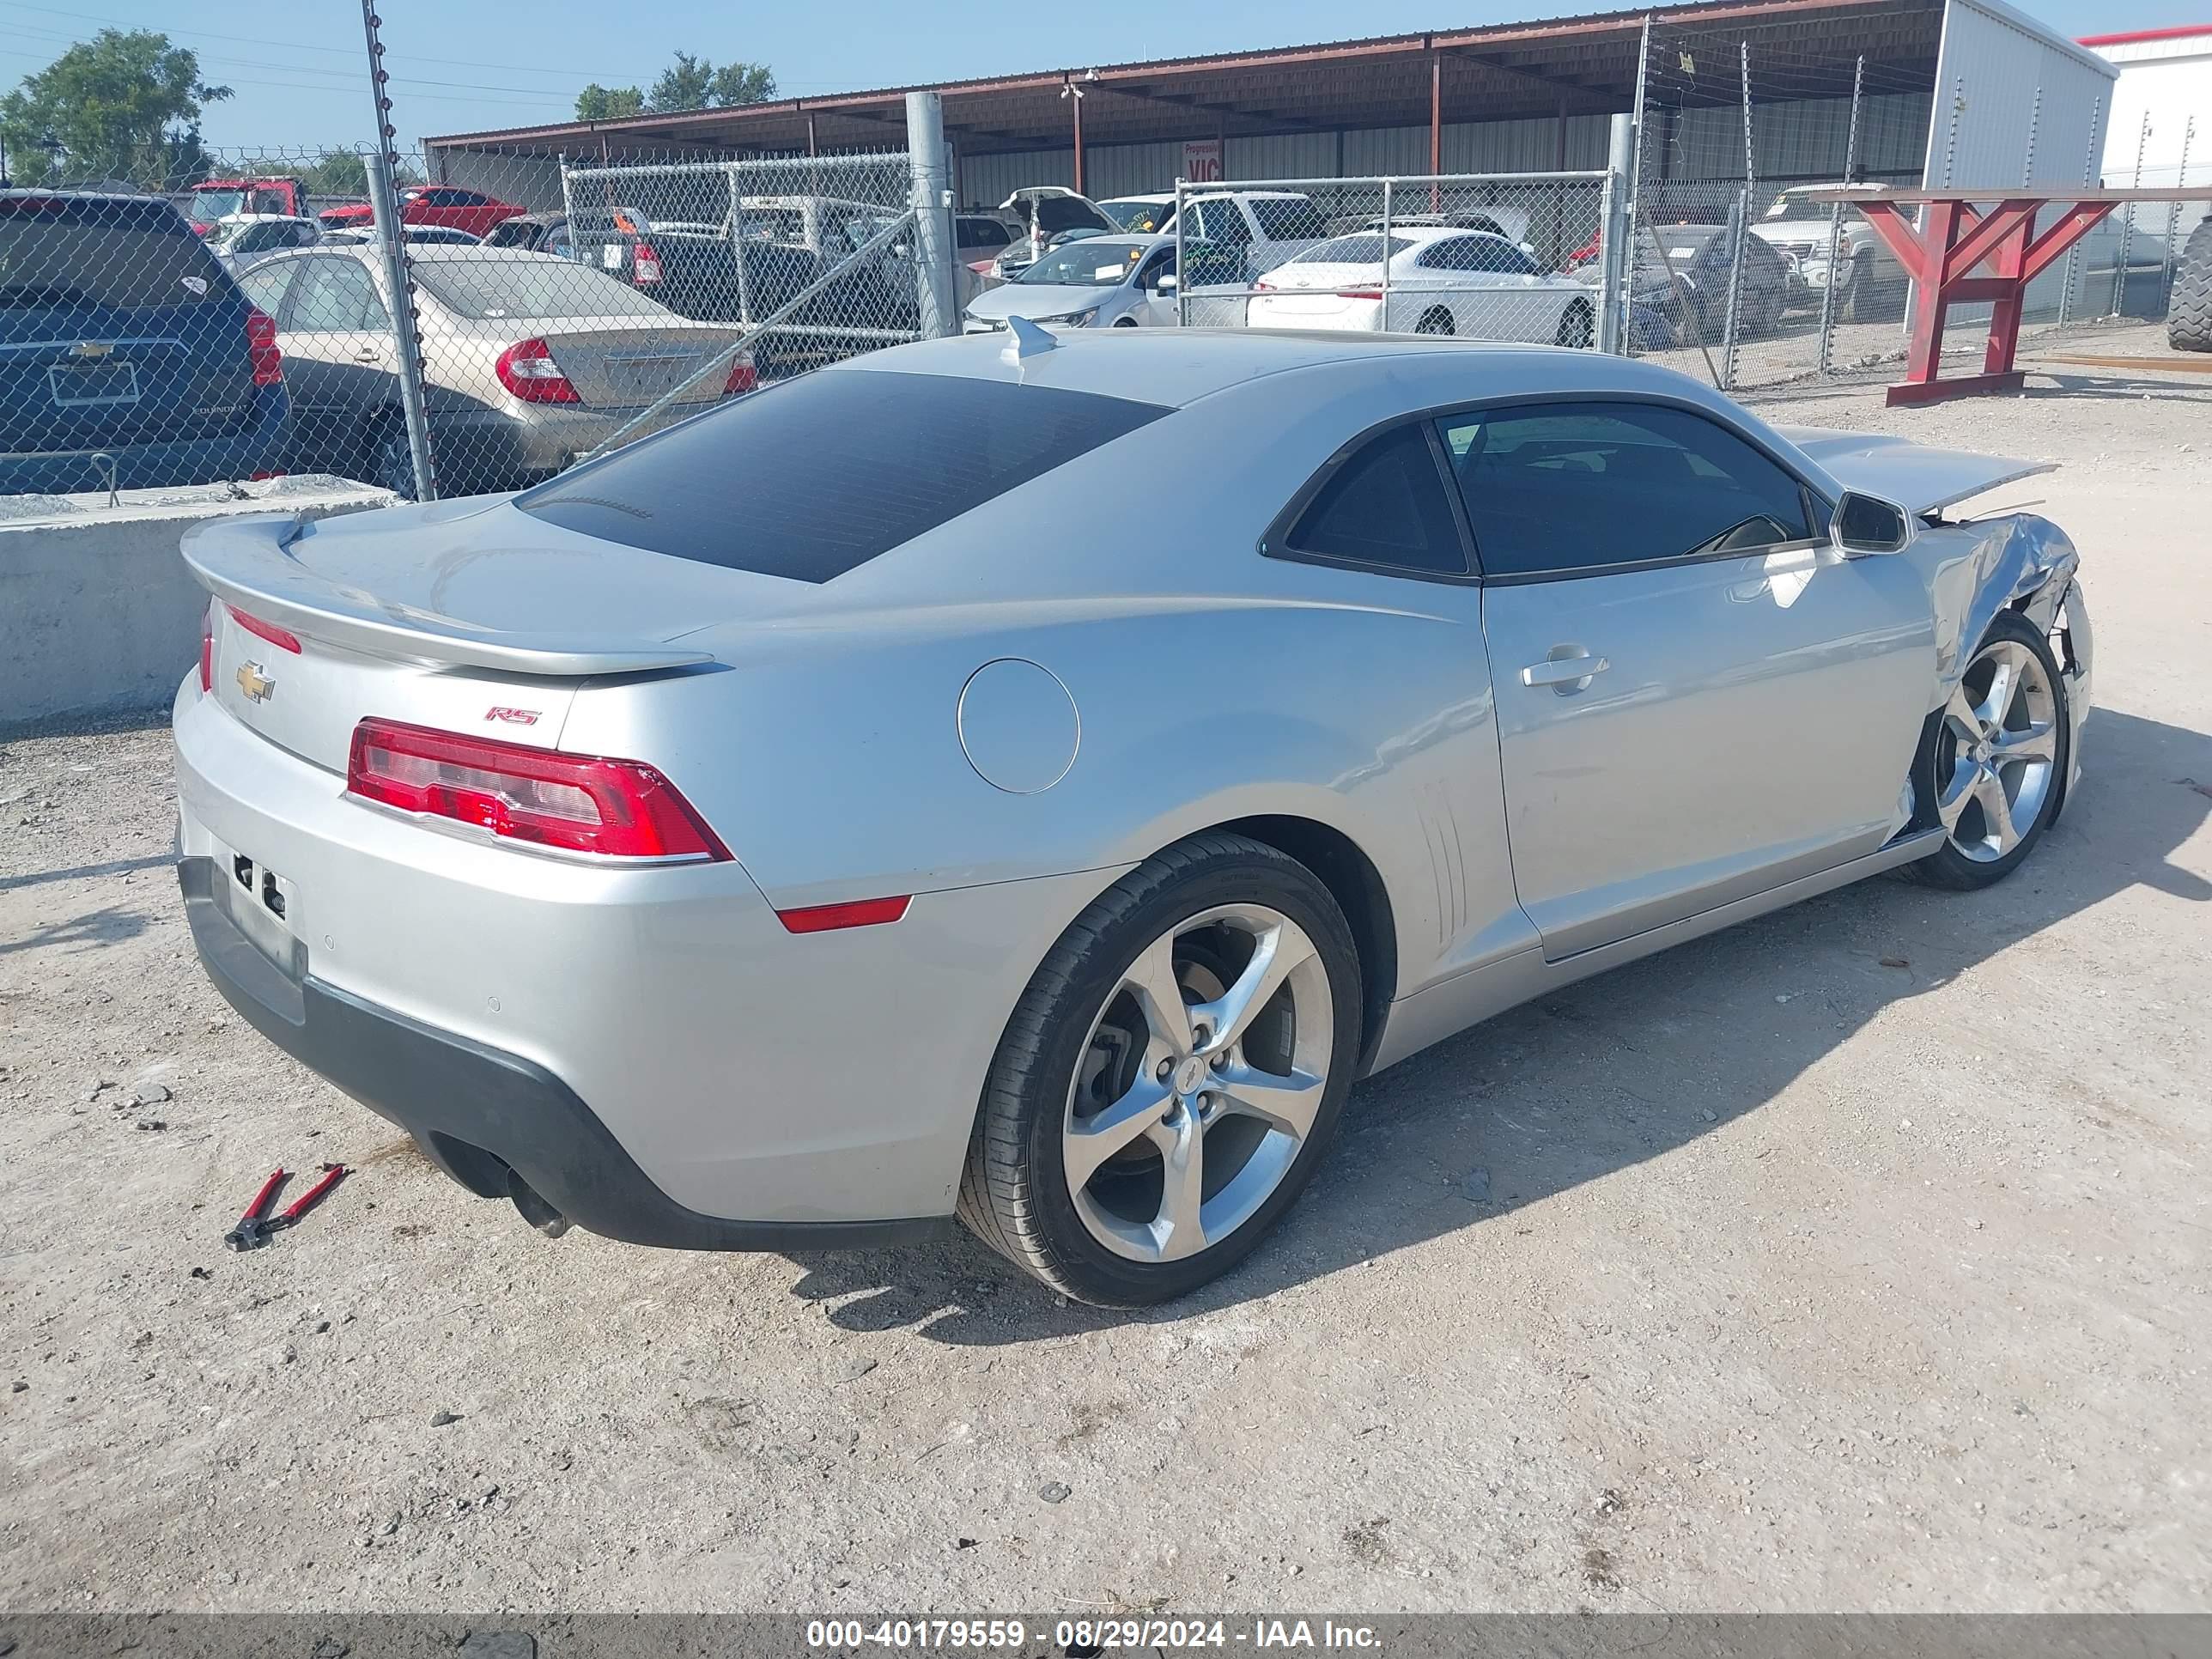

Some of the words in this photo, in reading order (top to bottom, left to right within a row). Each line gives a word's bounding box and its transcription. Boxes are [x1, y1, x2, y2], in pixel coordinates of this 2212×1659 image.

[1185, 142, 1218, 155] Progressiv
[1188, 158, 1218, 182] VIC
[483, 706, 543, 725] RS
